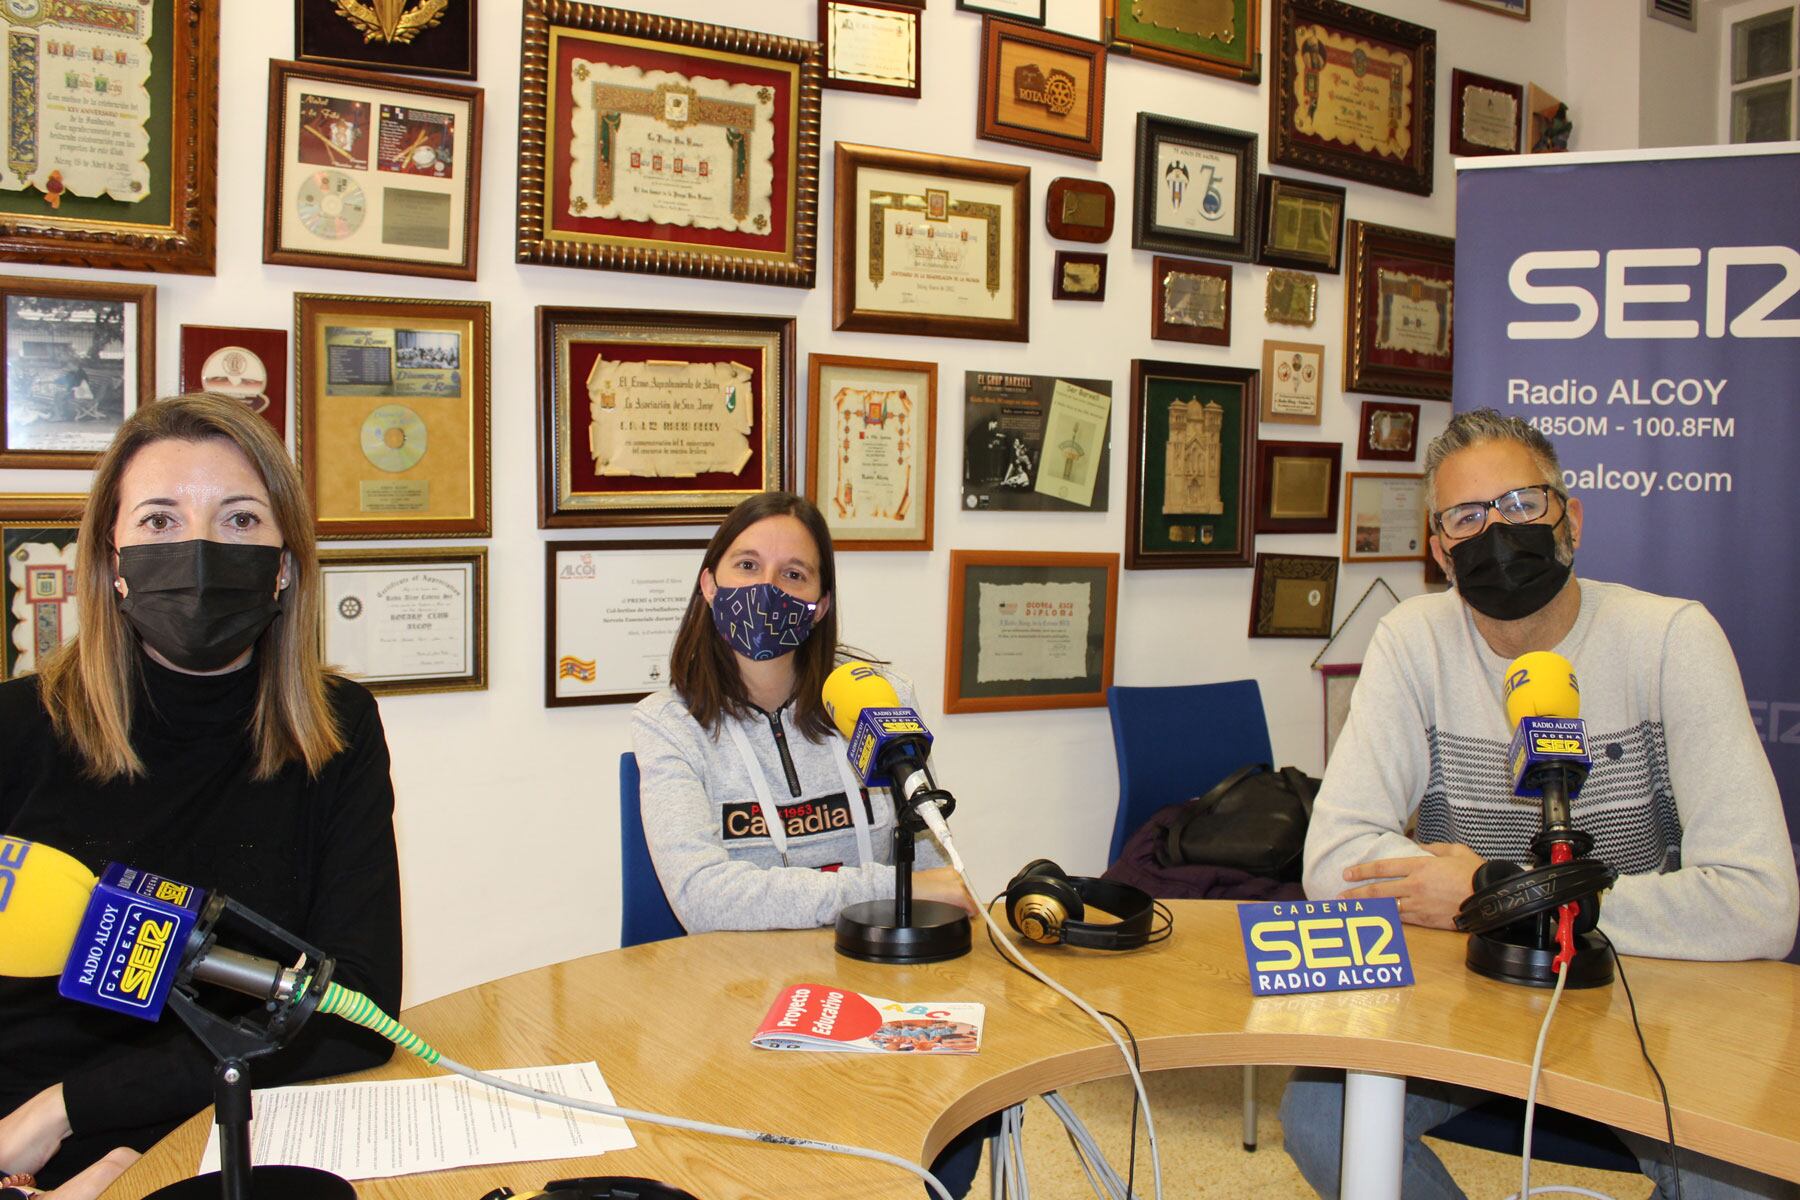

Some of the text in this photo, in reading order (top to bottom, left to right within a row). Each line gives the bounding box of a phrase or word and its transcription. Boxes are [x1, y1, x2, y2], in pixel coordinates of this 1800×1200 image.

[1507, 245, 1800, 340] SER
[1507, 379, 1728, 406] Radio ALCOY
[1510, 416, 1608, 436] 485OM
[1632, 418, 1735, 437] 100.8FM
[1562, 464, 1732, 497] oalcoy.com
[1555, 722, 1578, 730] ALCOY
[1536, 738, 1584, 754] SER
[727, 804, 850, 836] Caadia
[1274, 902, 1364, 915] CADENA
[78, 904, 119, 985] RADIO ALCOY
[106, 912, 142, 992] CADENA
[120, 920, 173, 1000] SER
[1250, 916, 1400, 972] SER
[1259, 966, 1403, 990] RADIO ALCOY
[777, 988, 811, 1028] Proyecto
[812, 991, 844, 1036] Educativo
[906, 1004, 929, 1015] B
[926, 1010, 950, 1020] C
